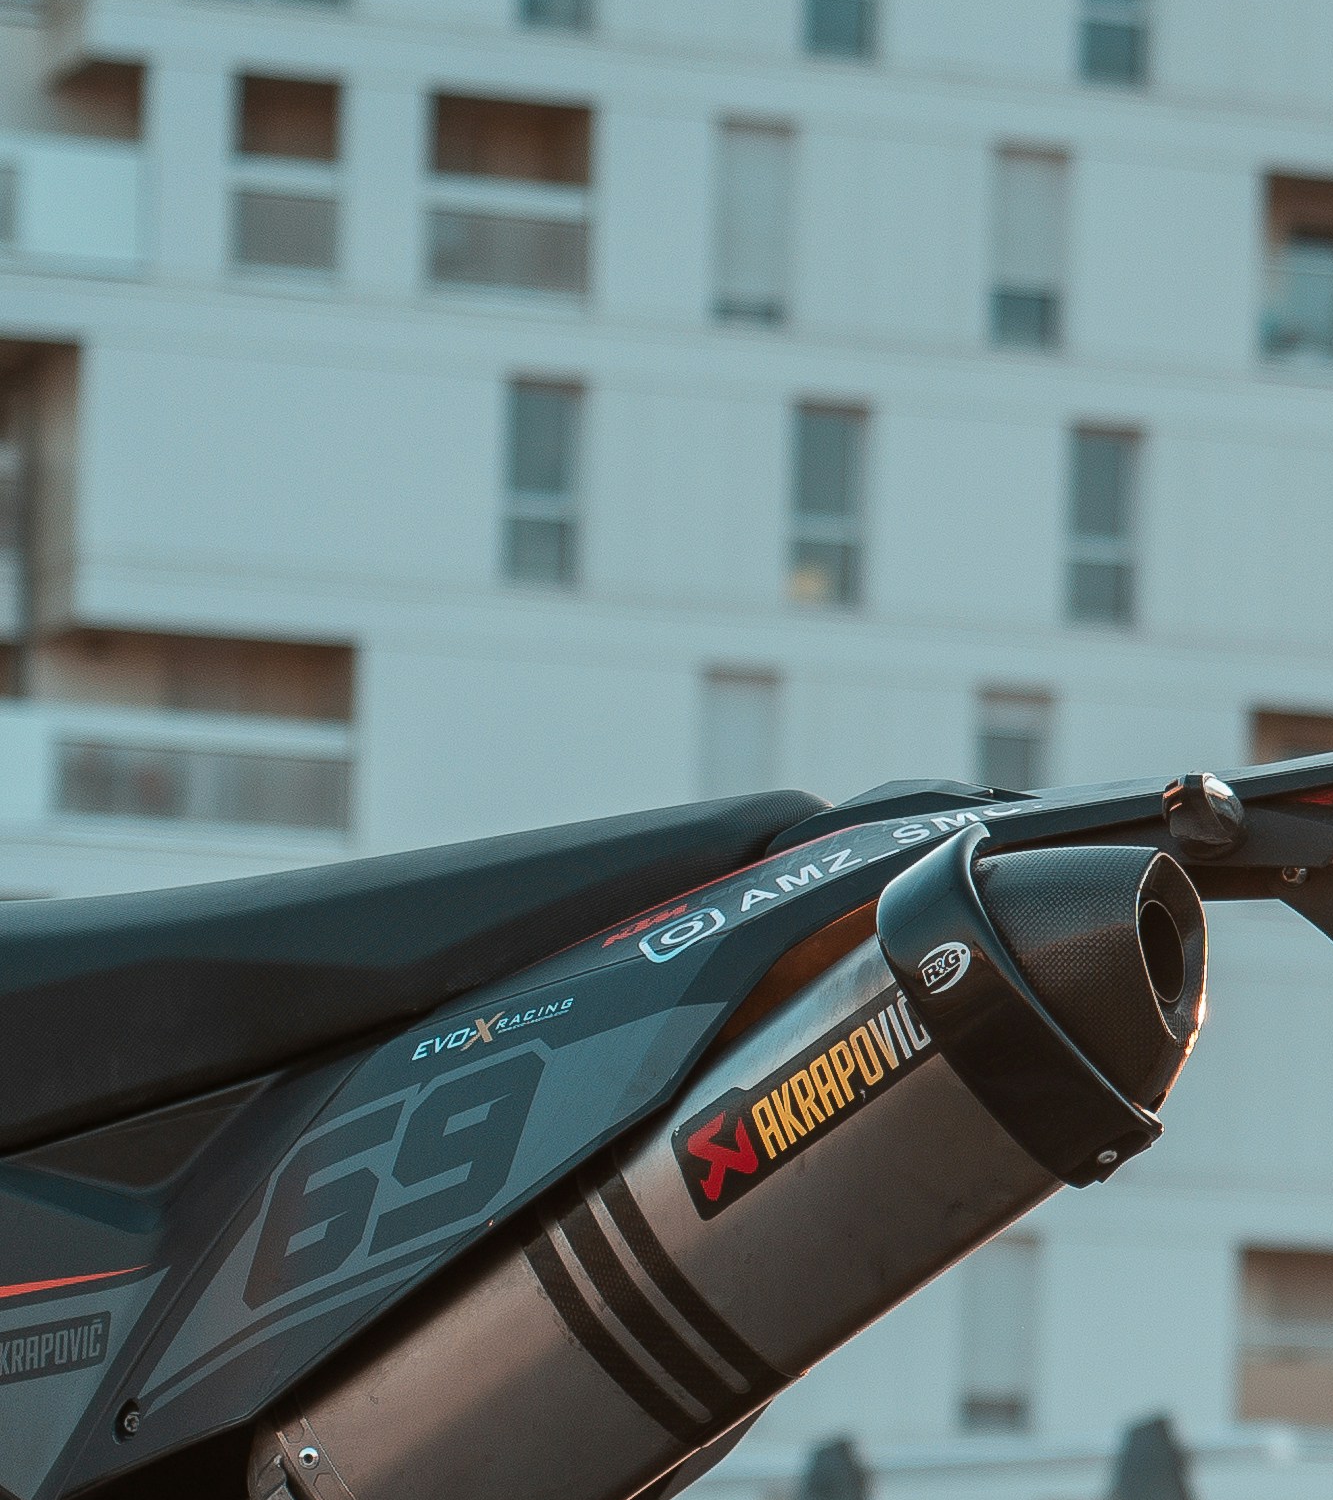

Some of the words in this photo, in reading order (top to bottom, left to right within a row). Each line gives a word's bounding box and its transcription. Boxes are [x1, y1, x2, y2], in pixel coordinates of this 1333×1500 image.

[921, 949, 962, 987] R&G
[242, 1051, 546, 1310] 69
[0, 1319, 103, 1377] KRAPOVIČ
